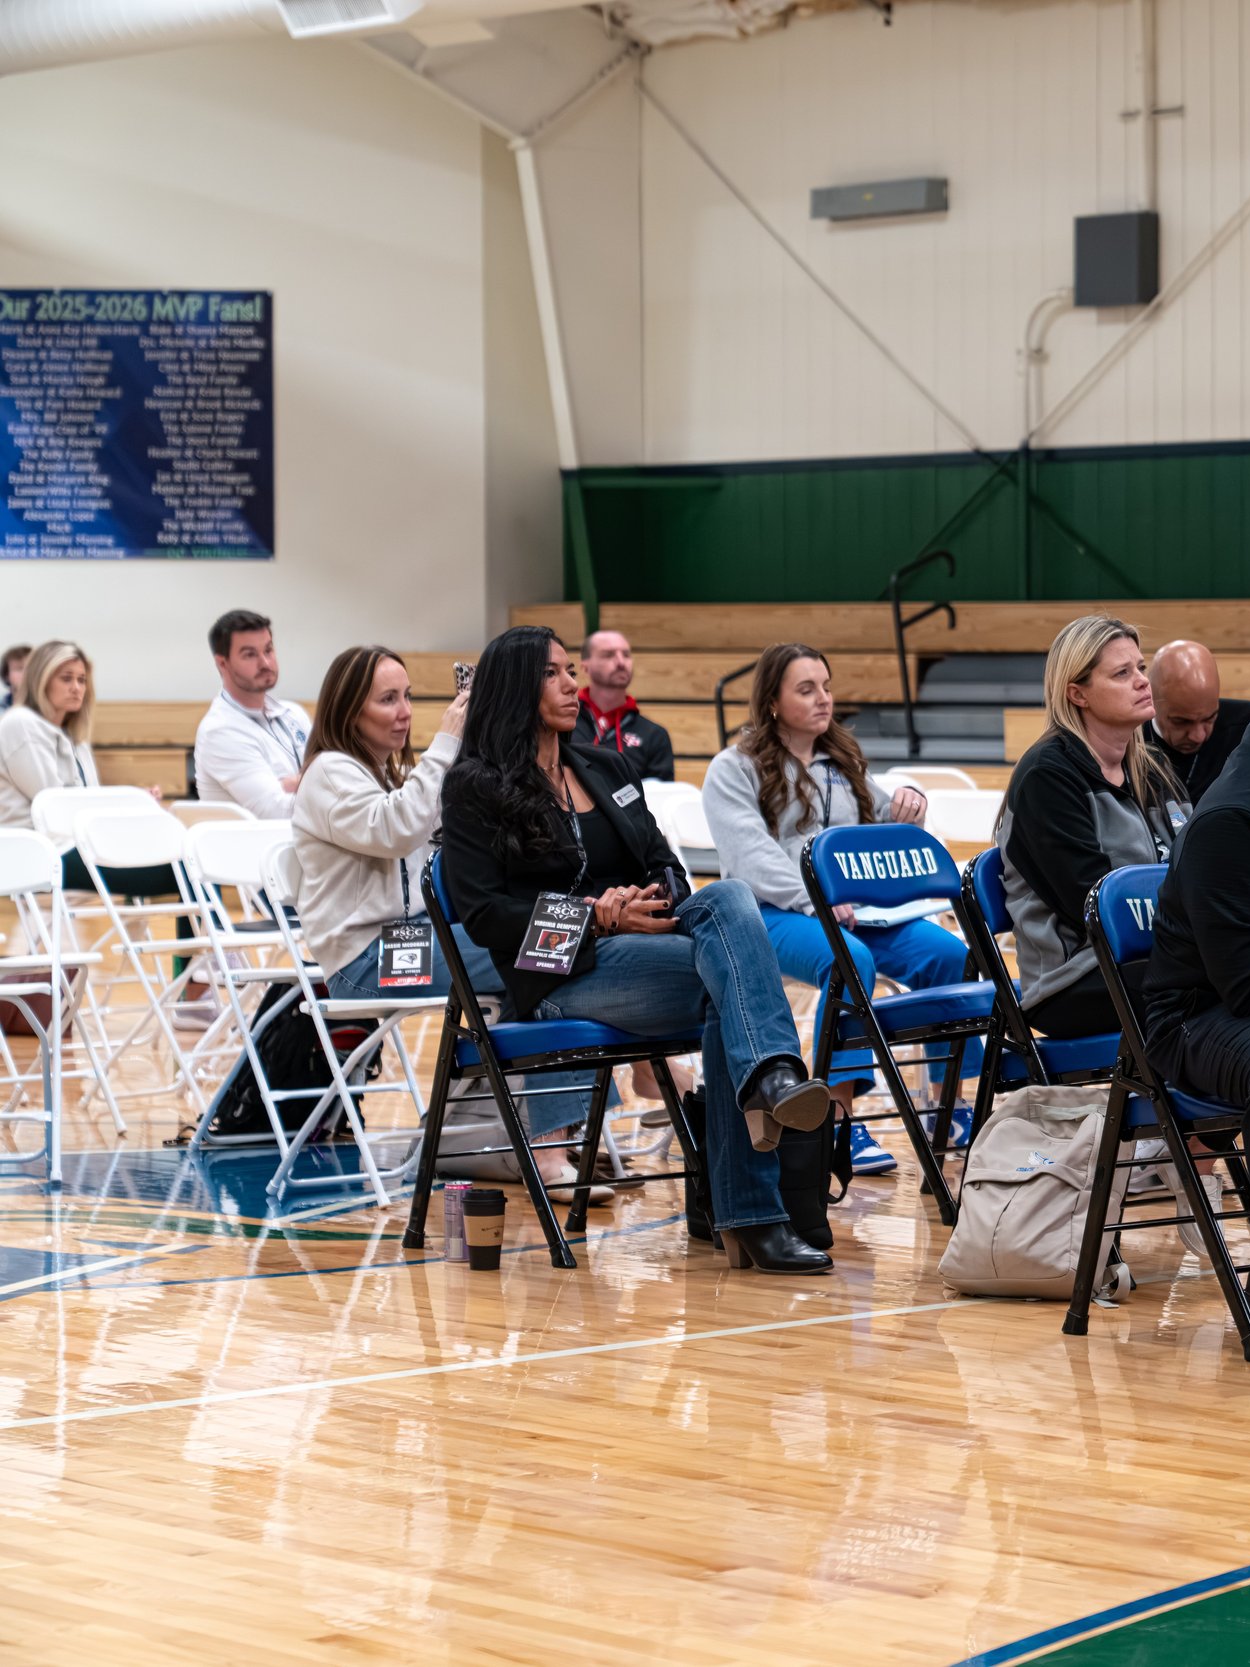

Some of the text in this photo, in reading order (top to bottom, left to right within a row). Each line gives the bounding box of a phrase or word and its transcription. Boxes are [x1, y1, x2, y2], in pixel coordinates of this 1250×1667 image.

[36, 294, 147, 321] 2025-2026
[153, 294, 203, 321] MVP
[208, 296, 263, 322] Fans!
[834, 847, 939, 880] VANGUARD
[546, 906, 580, 917] PSCC
[534, 920, 556, 929] VIRGINIA
[392, 929, 424, 938] PSCC
[535, 961, 556, 969] SPEAKER
